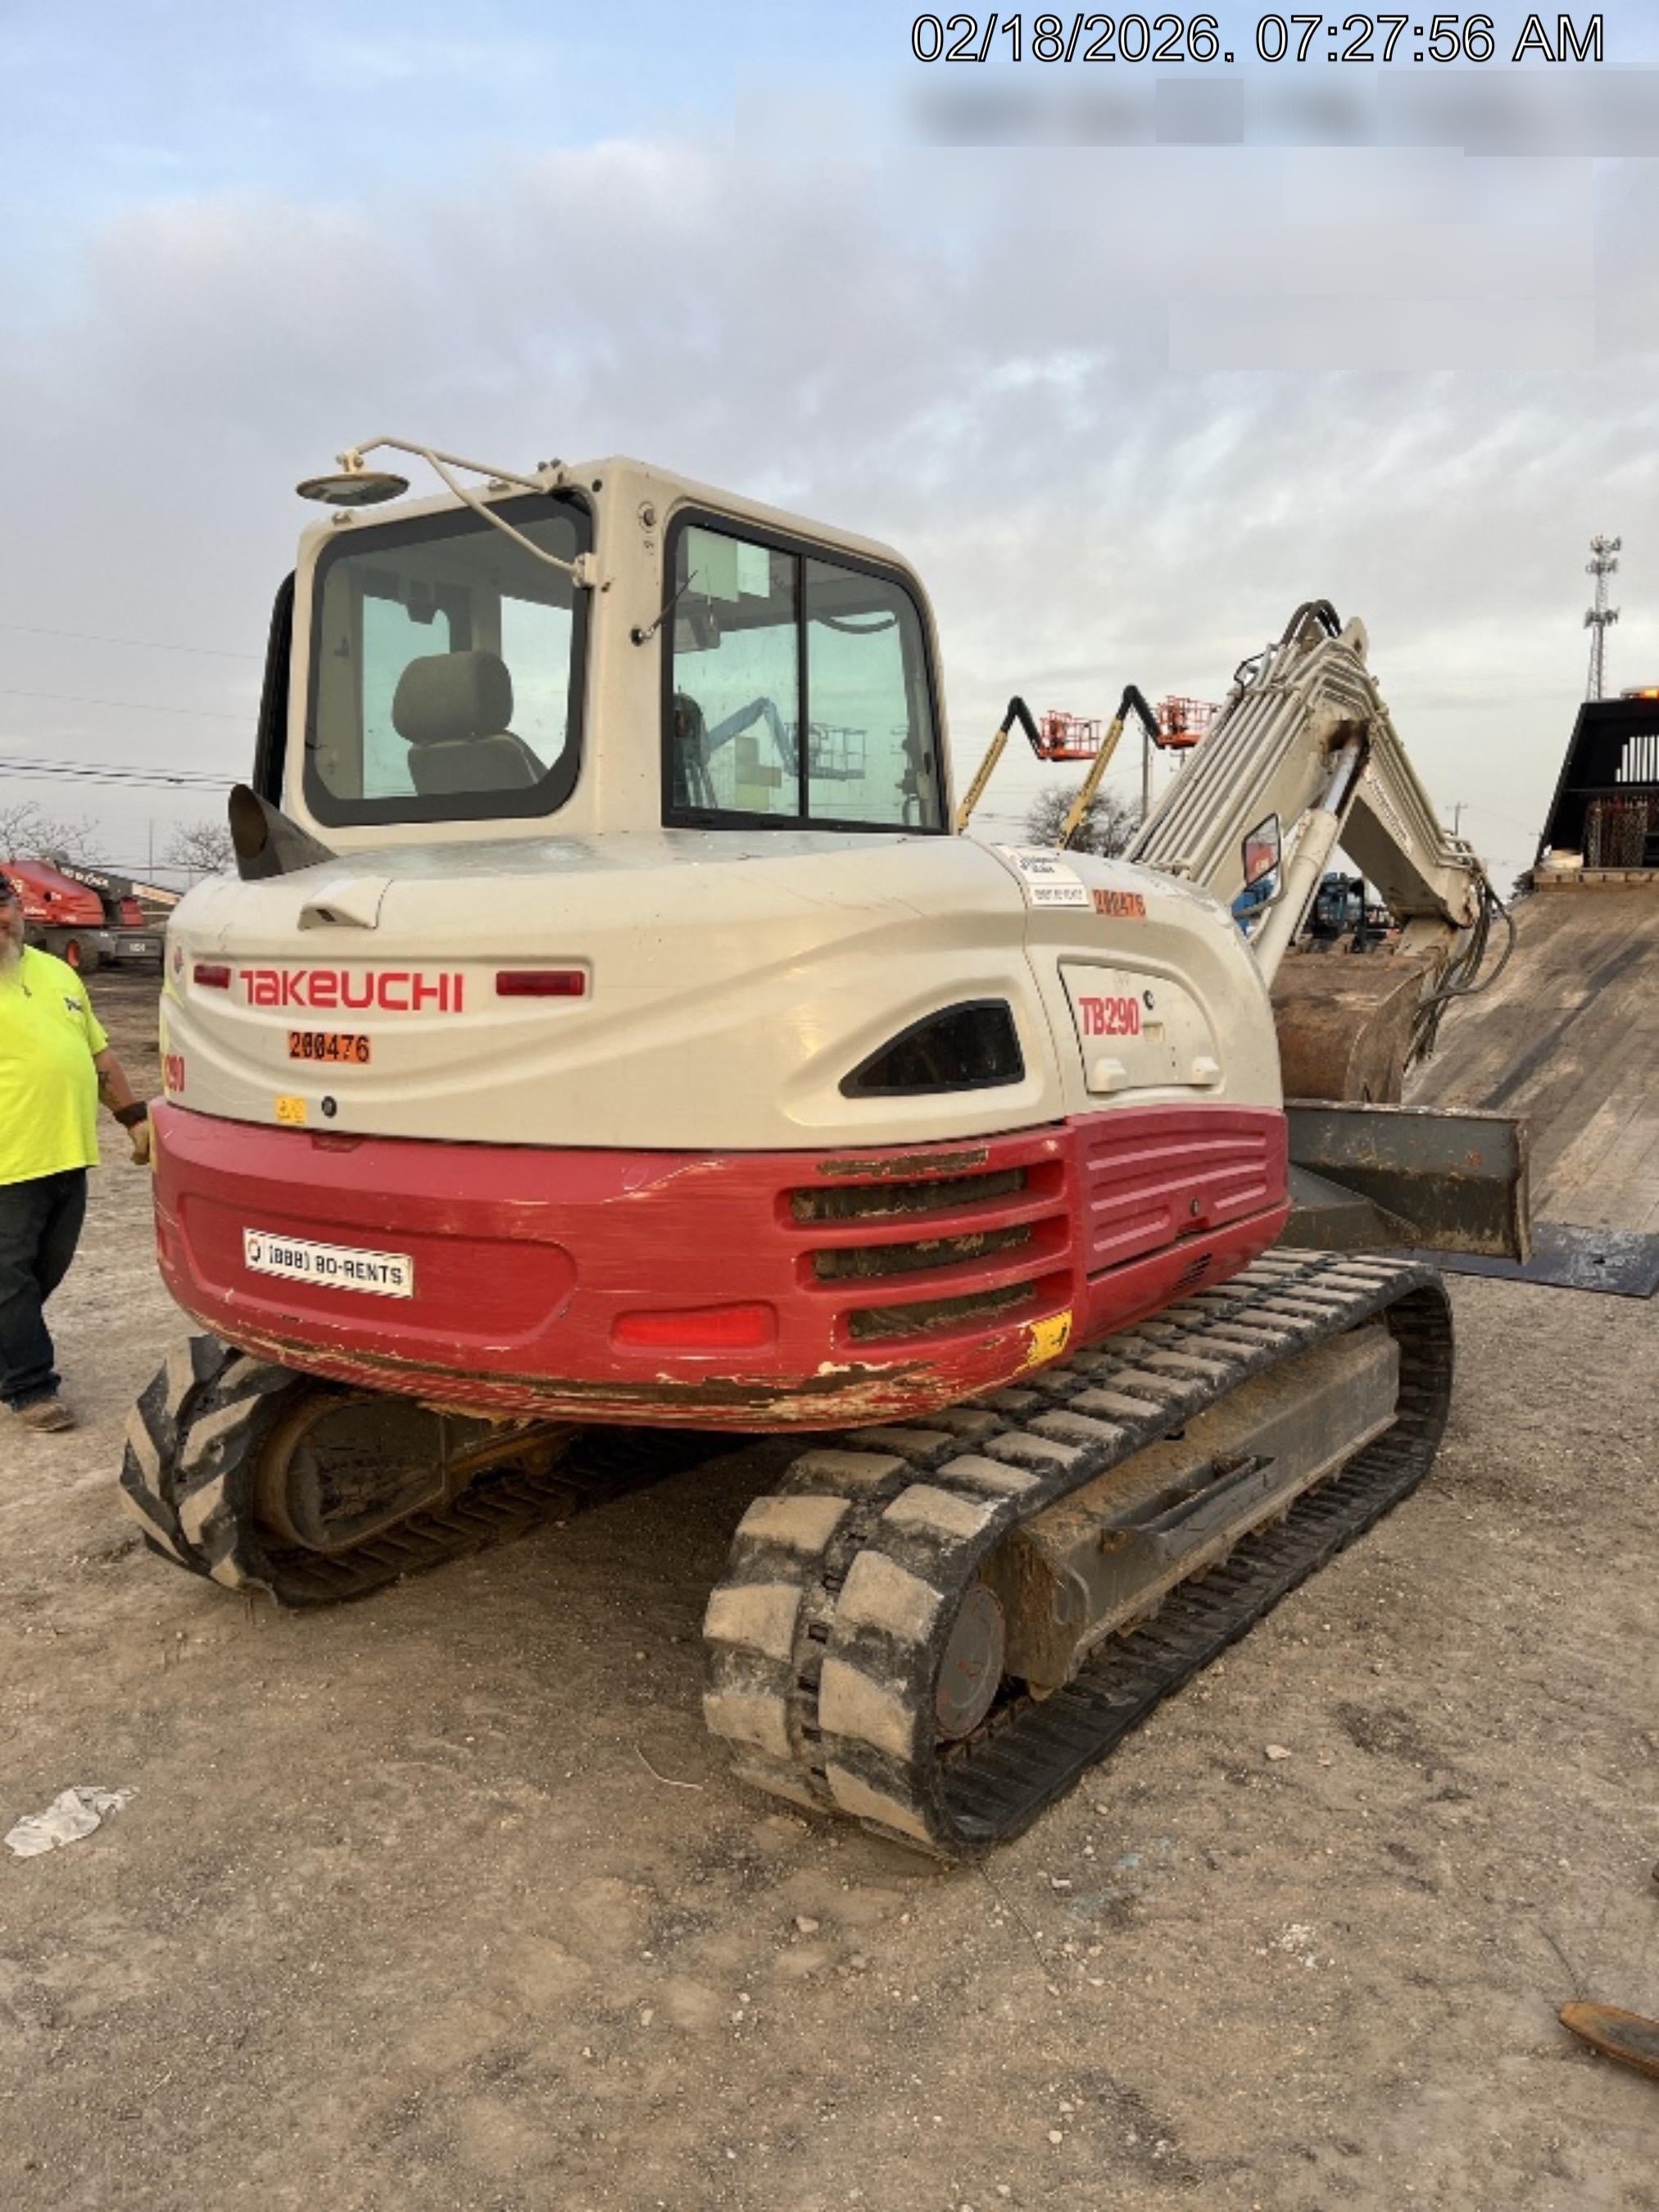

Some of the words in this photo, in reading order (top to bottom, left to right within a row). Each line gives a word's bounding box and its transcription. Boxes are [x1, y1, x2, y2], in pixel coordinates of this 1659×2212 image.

[1079, 998, 1141, 1036] TB290
[289, 1031, 369, 1063] 200476
[269, 1244, 309, 1271] (888)
